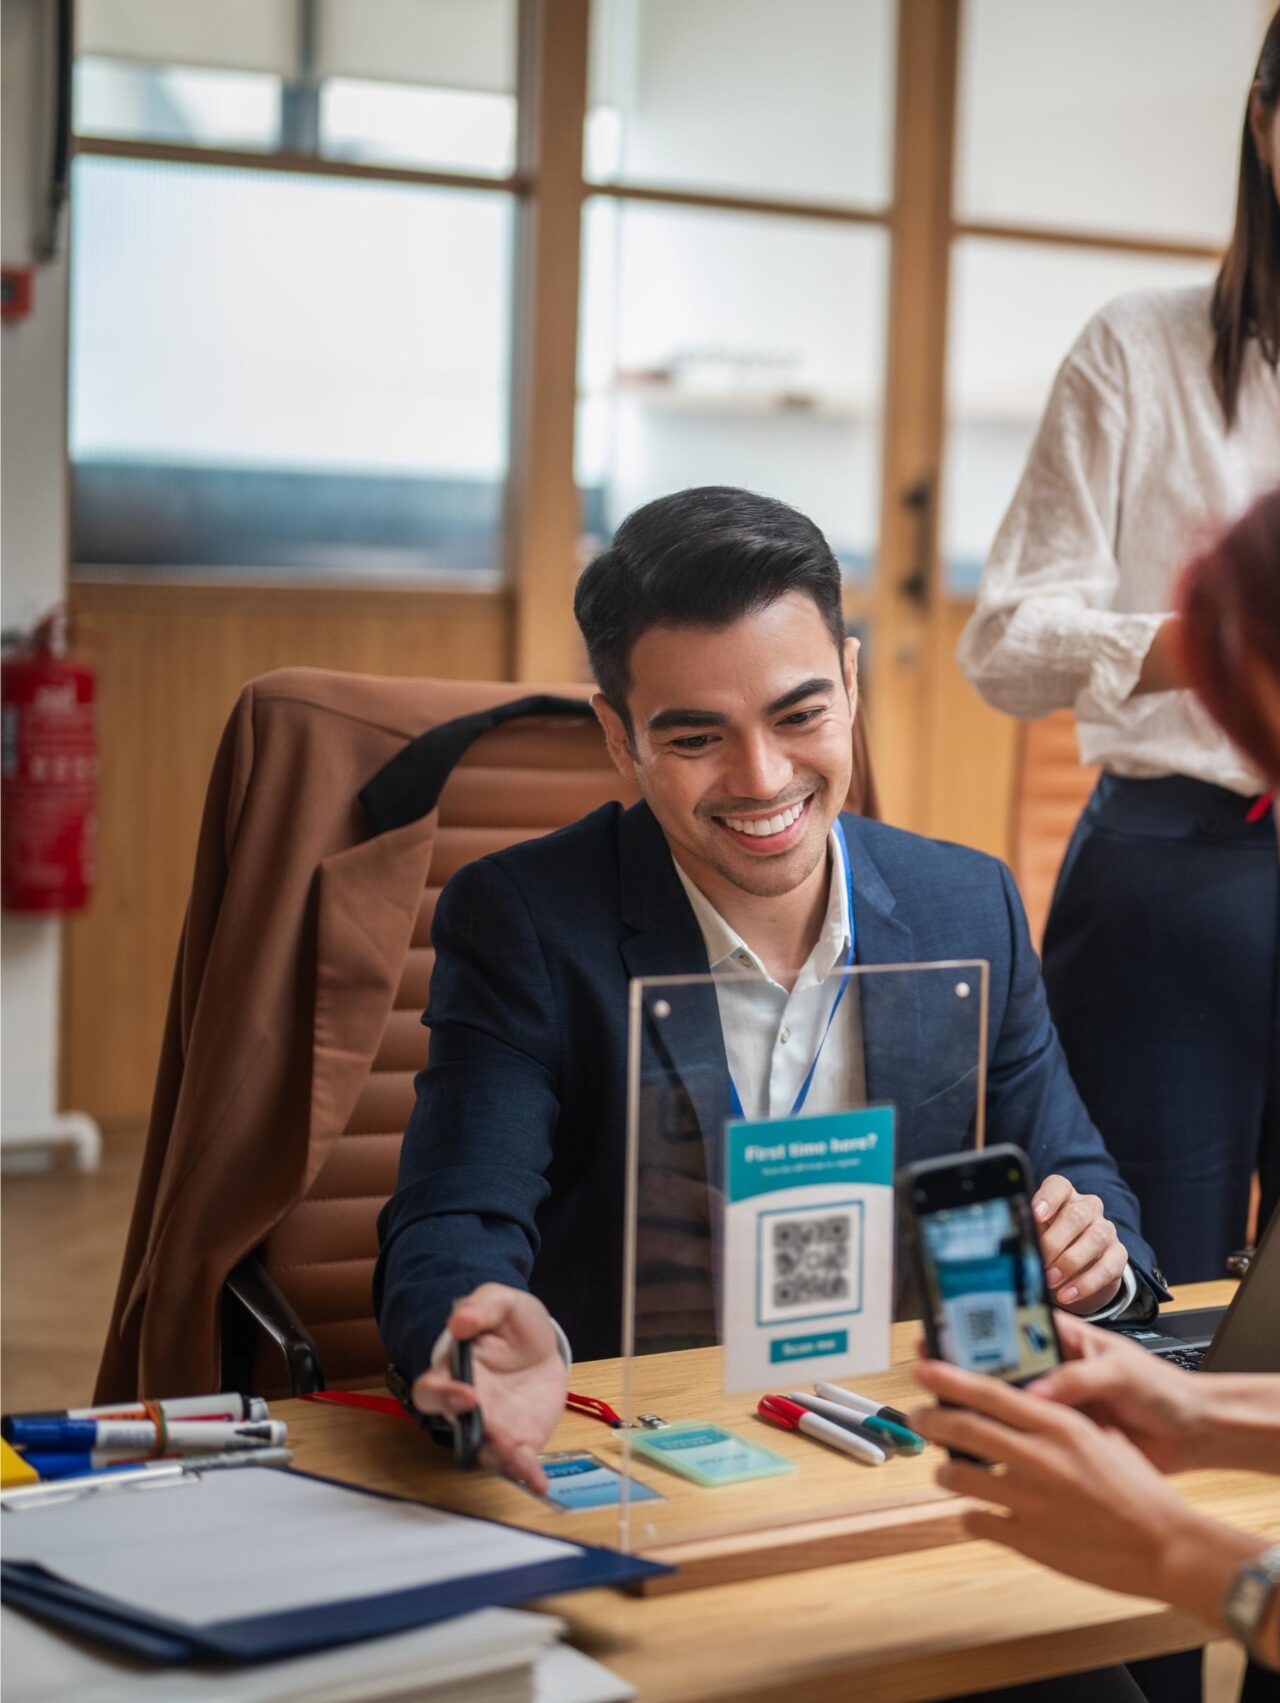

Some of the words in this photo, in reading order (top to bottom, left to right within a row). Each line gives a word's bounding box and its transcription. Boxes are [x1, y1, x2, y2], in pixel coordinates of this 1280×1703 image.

[744, 1145, 786, 1162] First
[788, 1141, 827, 1158] time
[830, 1132, 878, 1153] here?
